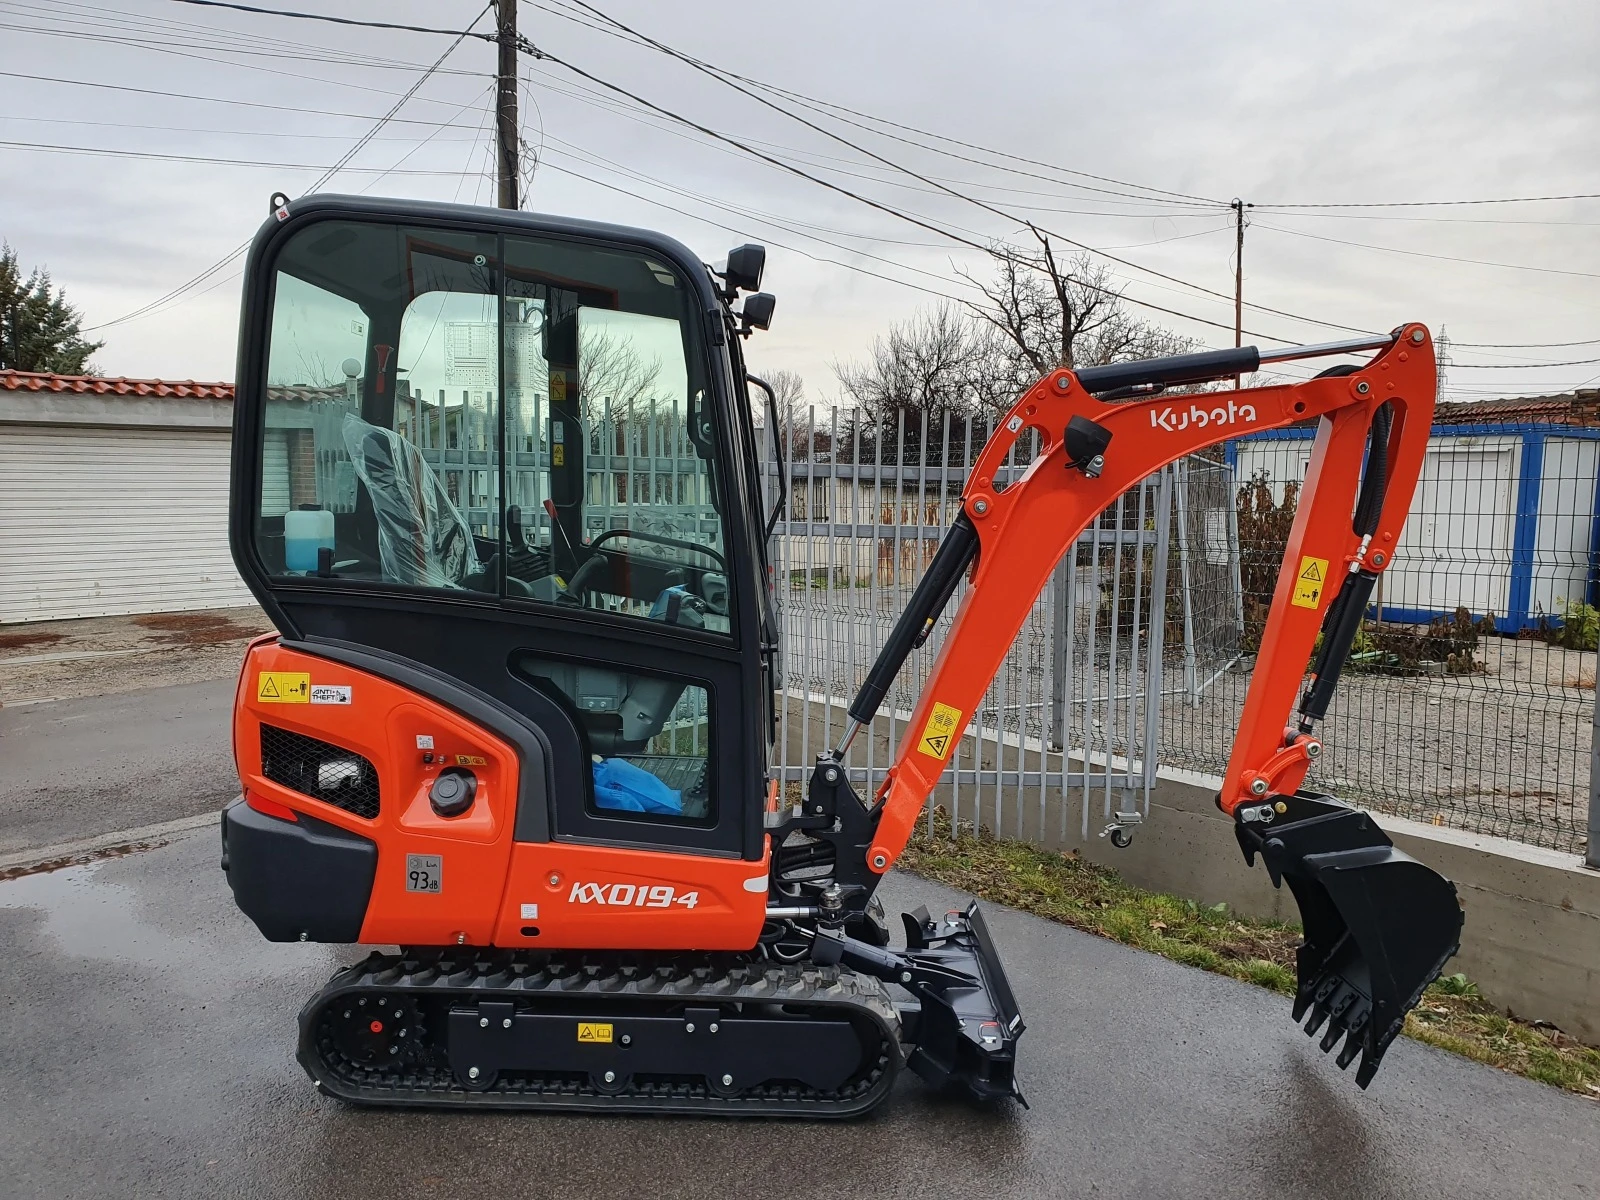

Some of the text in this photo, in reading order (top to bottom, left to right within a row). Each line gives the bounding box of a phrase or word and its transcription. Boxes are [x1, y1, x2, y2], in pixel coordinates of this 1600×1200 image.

[1150, 400, 1257, 432] Kubota
[409, 870, 439, 890] 93 dB
[568, 881, 699, 909] KX019-4
